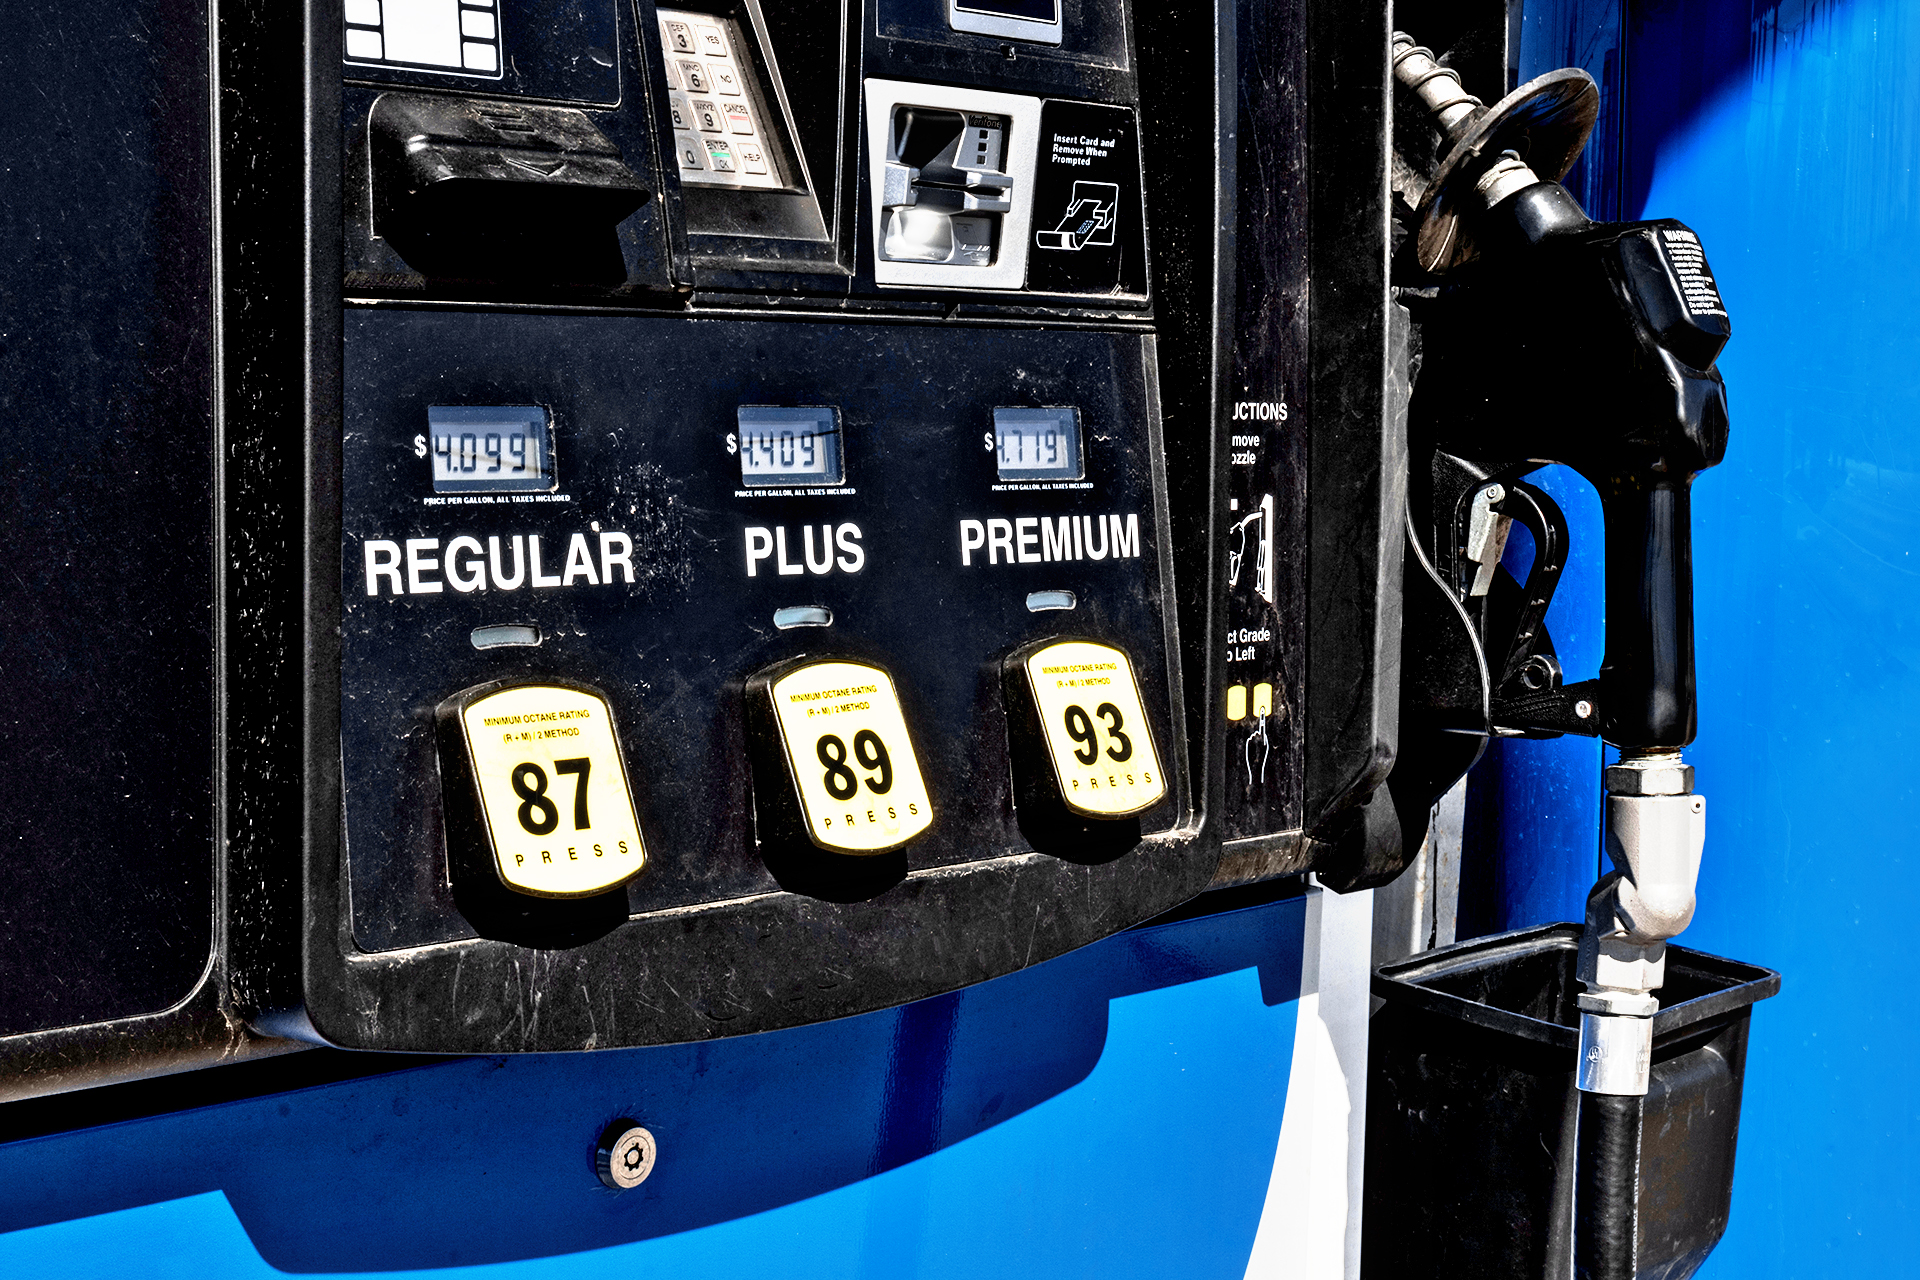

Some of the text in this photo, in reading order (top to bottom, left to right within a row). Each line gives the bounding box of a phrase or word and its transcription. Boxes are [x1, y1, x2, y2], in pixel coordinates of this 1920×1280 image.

[677, 34, 687, 48] 3
[705, 35, 720, 44] YES
[691, 74, 700, 87] 6
[720, 75, 732, 83] NO
[724, 103, 748, 114] CANCEL
[672, 110, 681, 124] 8
[704, 113, 713, 127] 9
[706, 141, 729, 150] ENTER
[1054, 133, 1115, 147] Insert Card and
[686, 150, 695, 164] 0
[1053, 143, 1107, 157] Remove When
[1052, 154, 1090, 166] Prompted
[1232, 435, 1260, 447] move
[424, 497, 445, 505] PRICE
[447, 497, 463, 505] PER
[512, 495, 534, 503] TAXES
[959, 513, 1140, 566] PREMIUM
[744, 522, 865, 577] PLUS
[364, 531, 636, 596] REGULAR
[1240, 627, 1270, 643] Grade
[1236, 646, 1255, 661] Left
[1042, 662, 1117, 674] MINIMUM OCTANE RATING
[1085, 677, 1111, 686] METHOD
[790, 685, 877, 702] MINIMUM OCTANE RATING
[840, 701, 870, 712] METHOD
[484, 709, 590, 726] MINIMUM OCTANE RATING
[544, 727, 580, 738] METHOD
[1064, 702, 1132, 766] 93
[816, 729, 893, 801] 89
[1072, 772, 1152, 791] PRESS
[511, 757, 591, 836] 87
[824, 803, 918, 829] PRESS
[516, 841, 628, 866] PRESS
